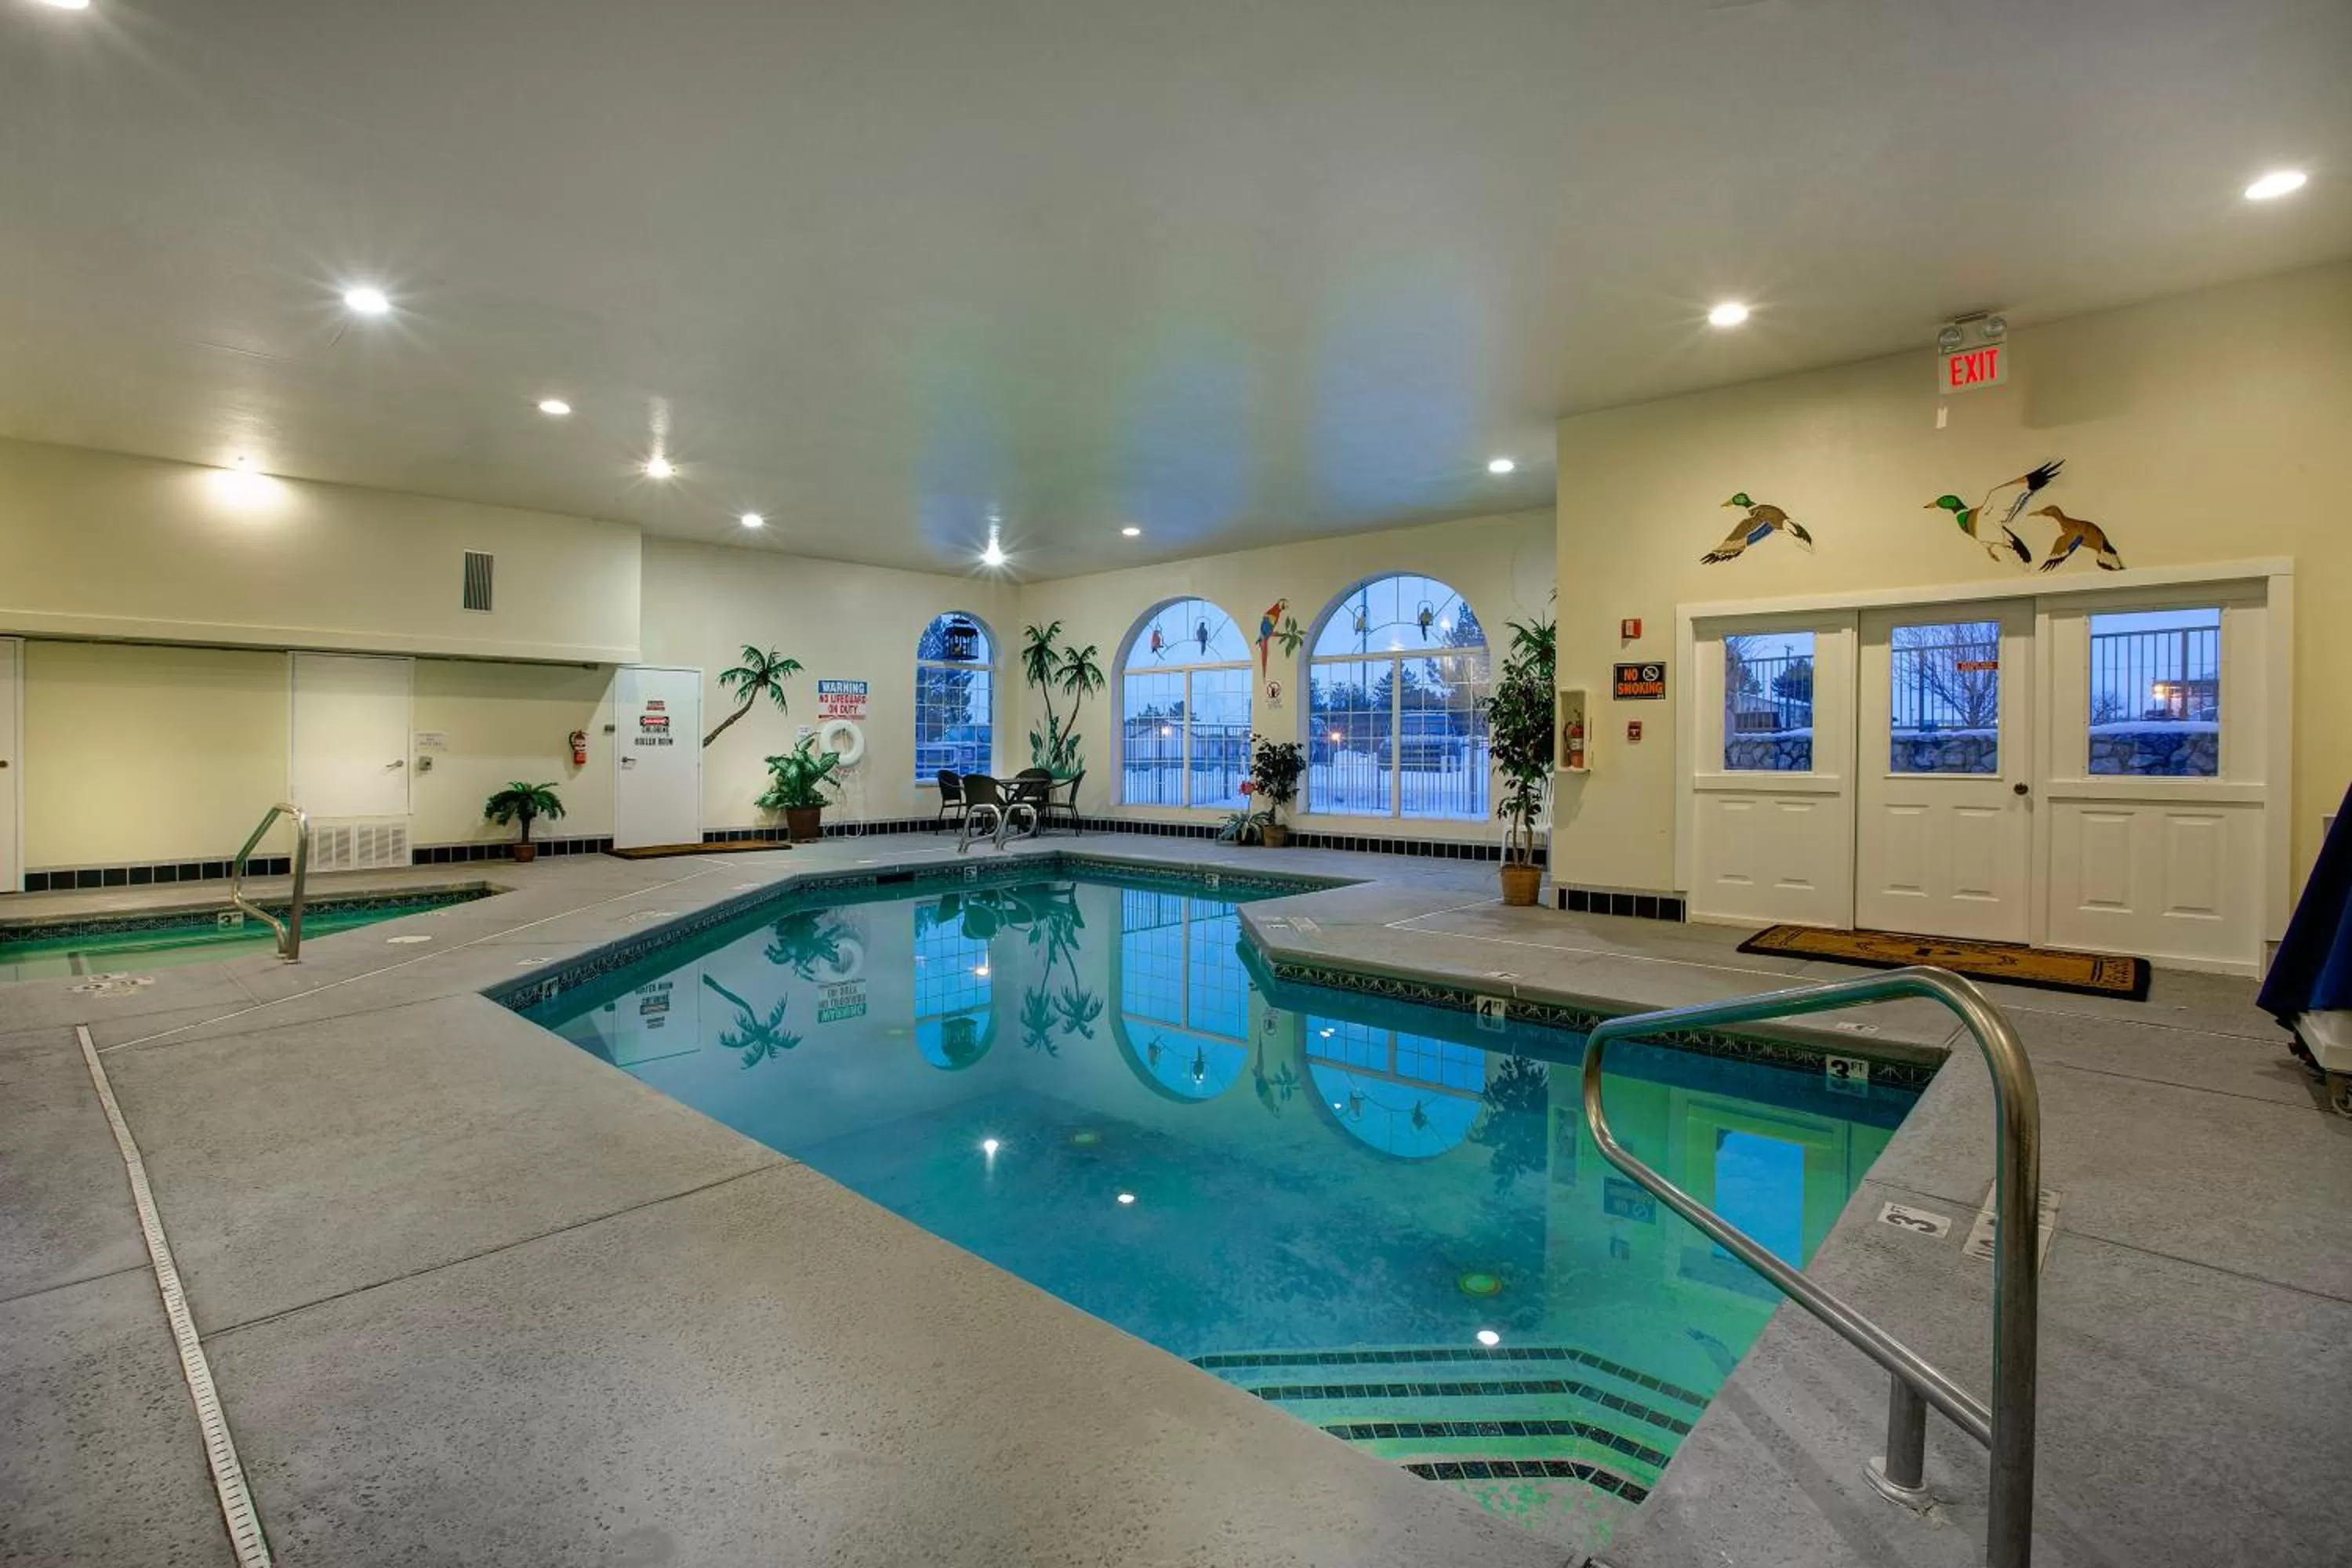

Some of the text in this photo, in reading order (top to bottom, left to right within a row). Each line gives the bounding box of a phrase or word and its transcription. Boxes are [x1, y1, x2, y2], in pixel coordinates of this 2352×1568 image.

[1950, 349, 1999, 387] EXIT
[1624, 668, 1639, 681] NO
[822, 681, 865, 694] WARNING
[1617, 681, 1664, 695] SMOKING
[840, 705, 858, 714] DUTY
[1479, 1000, 1493, 1017] 4
[1831, 1059, 1849, 1080] 3
[1886, 1213, 1938, 1233] 3
